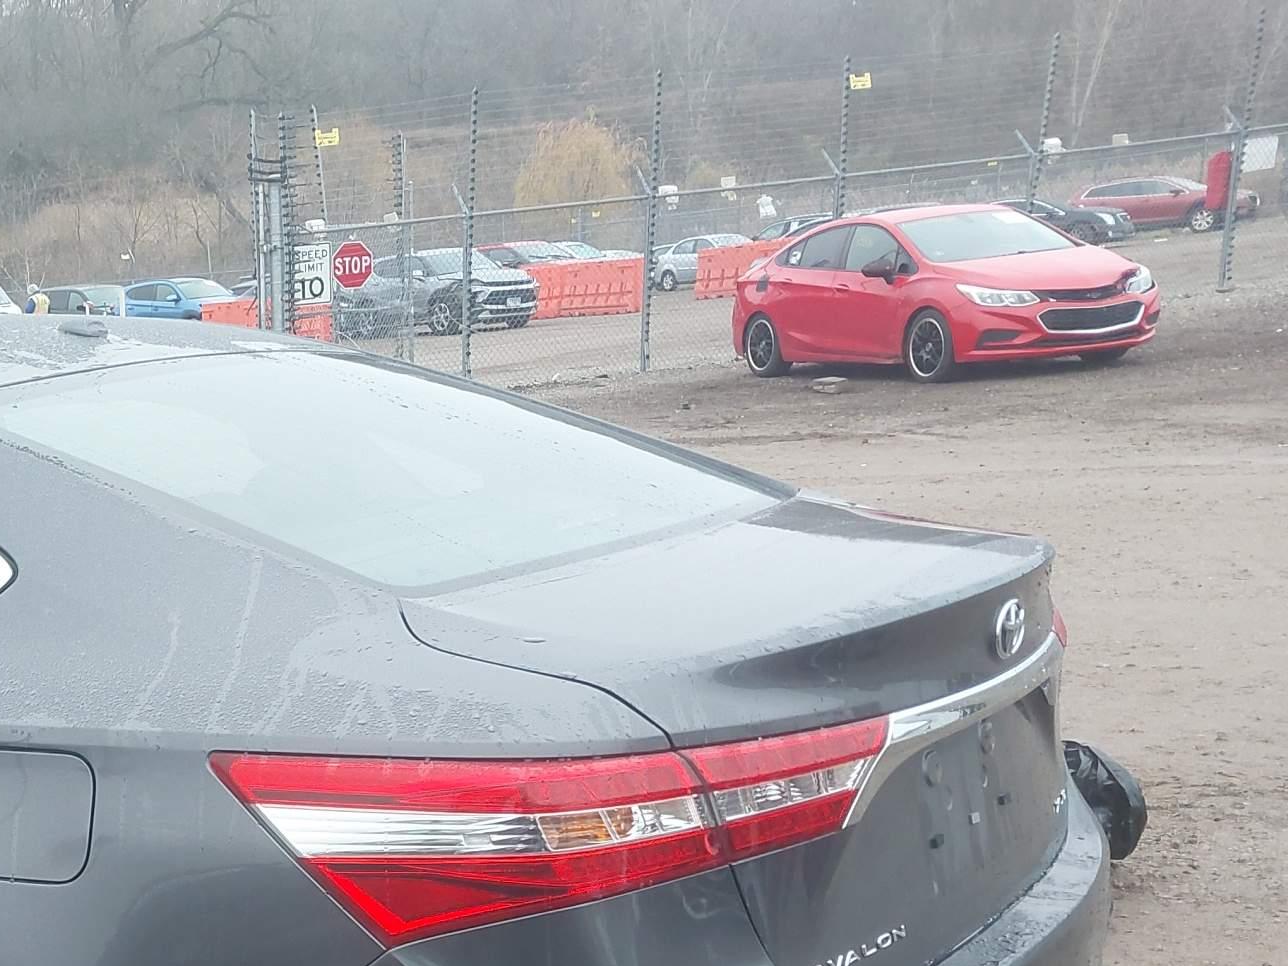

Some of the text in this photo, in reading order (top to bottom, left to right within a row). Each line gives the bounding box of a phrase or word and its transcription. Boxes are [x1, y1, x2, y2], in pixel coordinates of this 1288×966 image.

[295, 249, 328, 261] SPEED
[298, 263, 325, 274] LIMIT
[335, 256, 371, 276] STOP
[301, 277, 325, 299] 10
